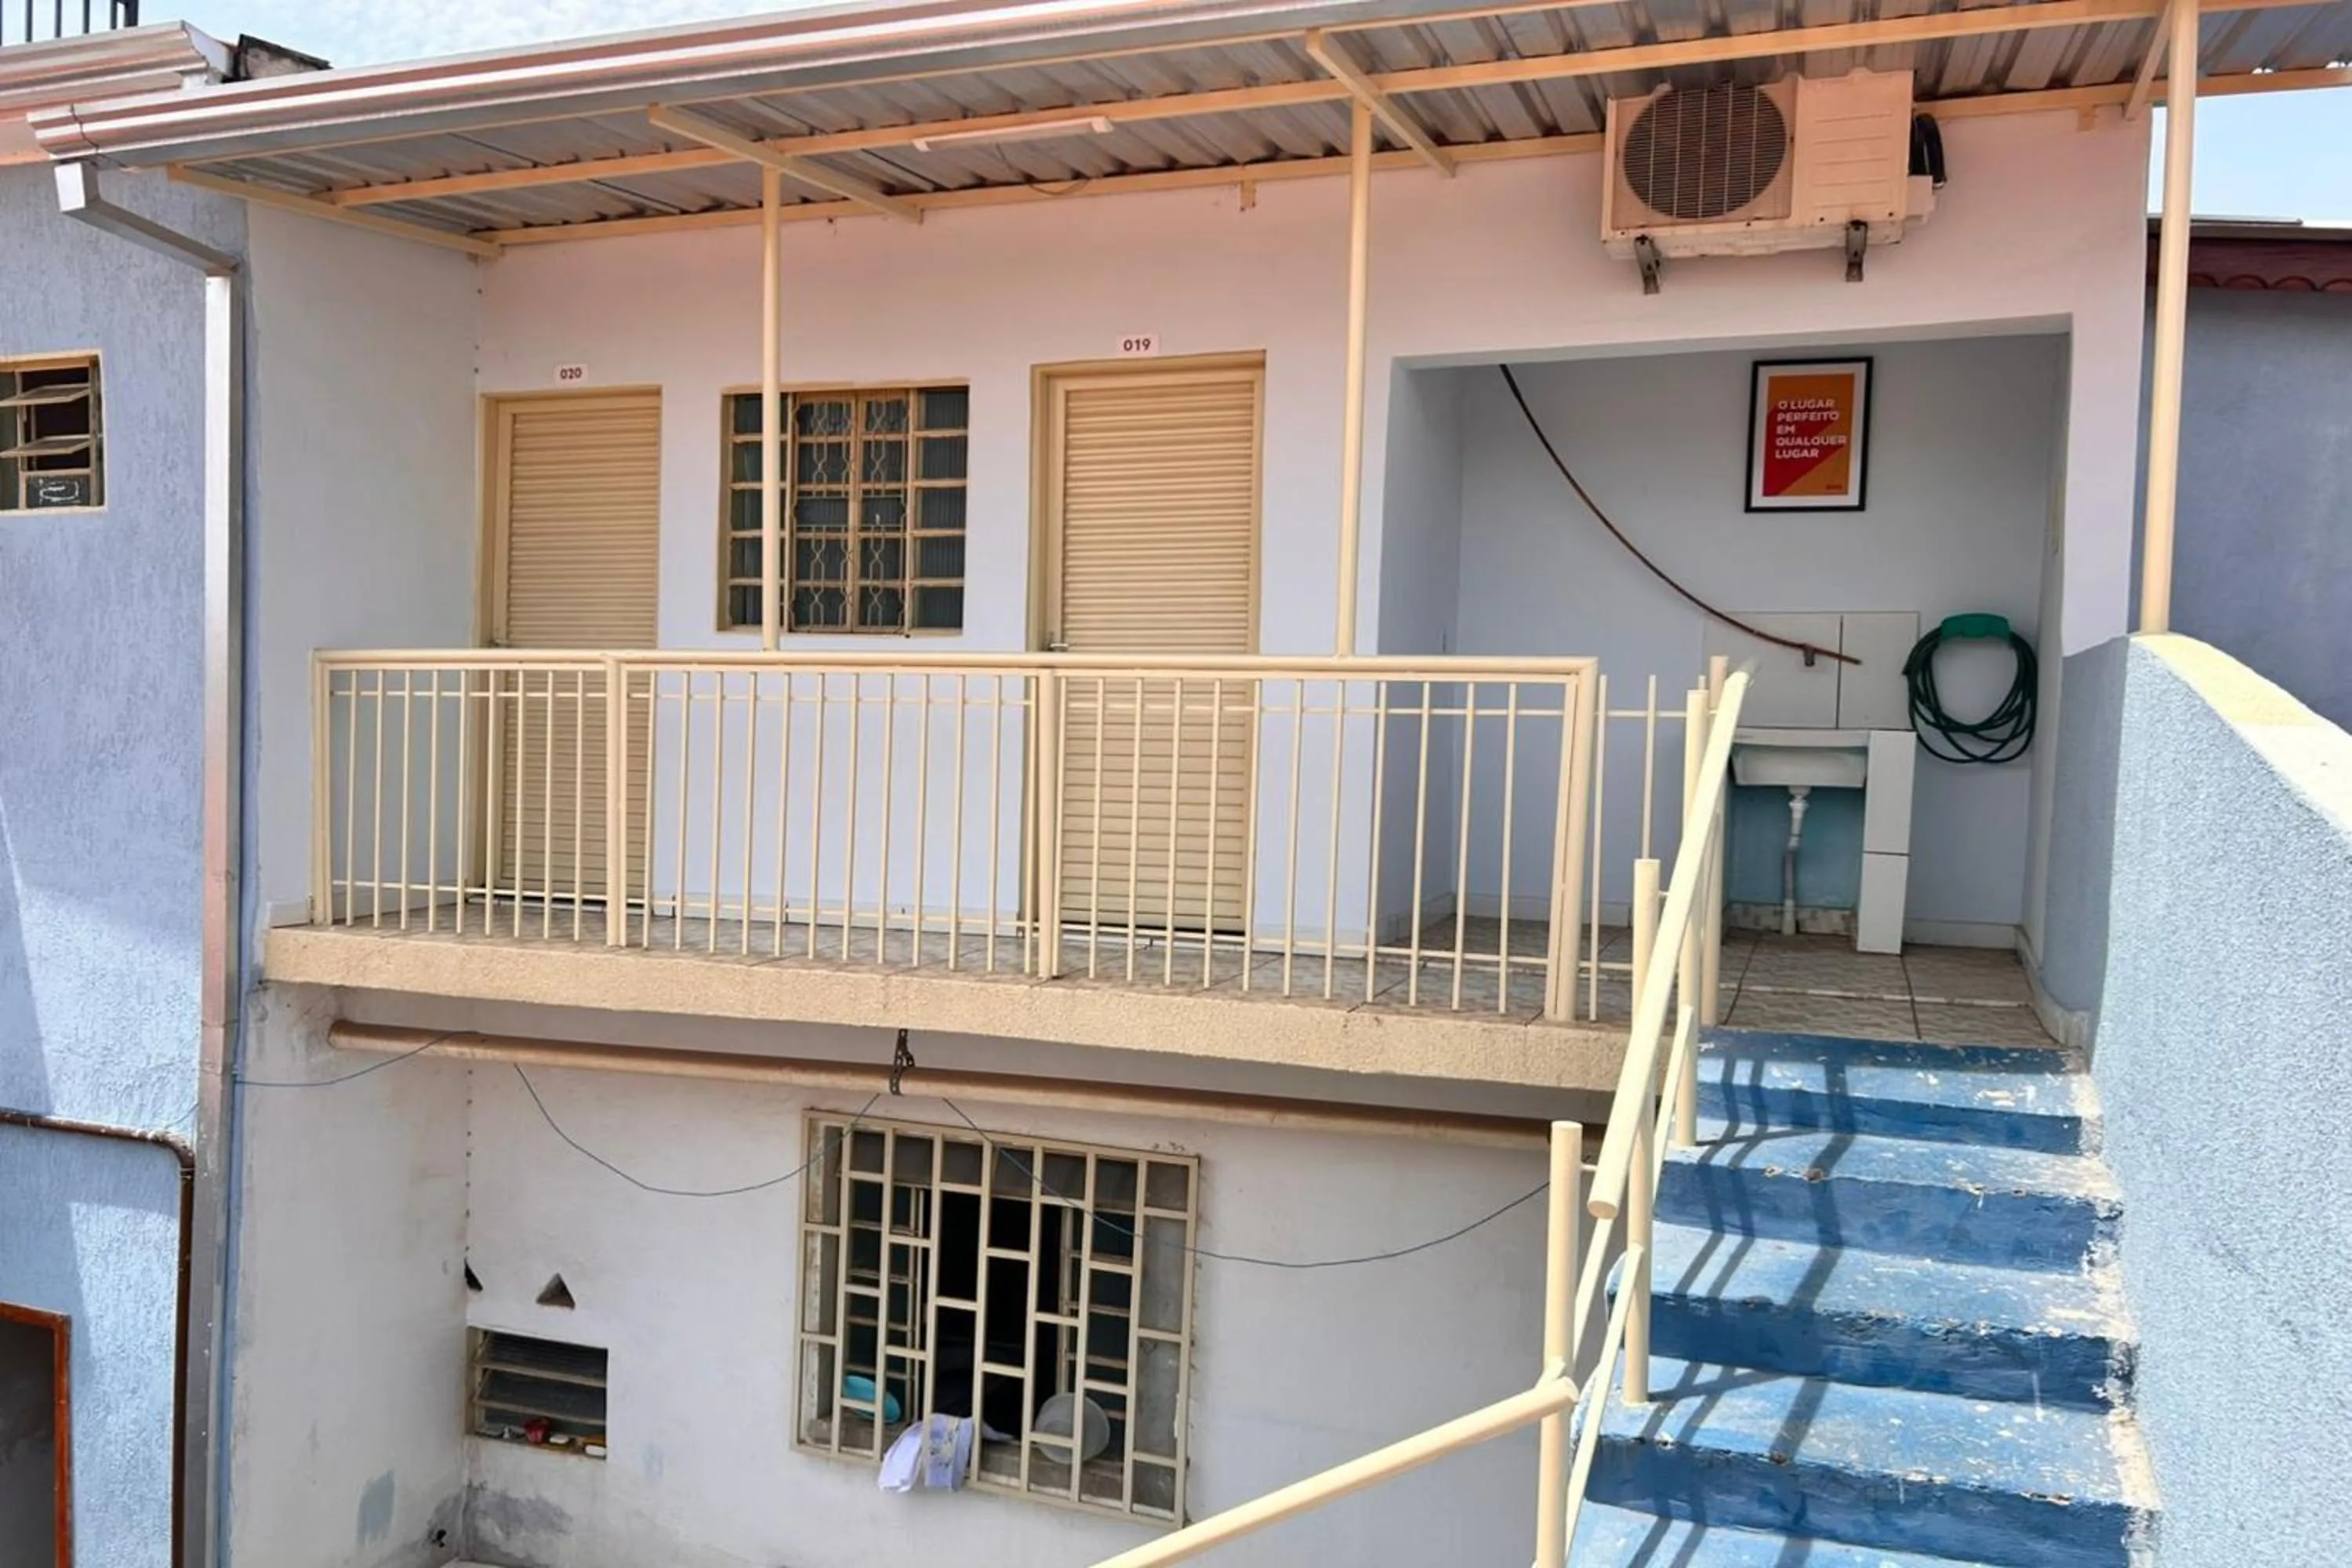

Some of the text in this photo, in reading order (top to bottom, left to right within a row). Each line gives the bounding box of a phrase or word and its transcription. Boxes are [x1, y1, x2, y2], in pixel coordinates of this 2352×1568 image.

[1123, 338, 1151, 351] 019
[560, 367, 583, 379] 020
[1778, 399, 1835, 409] O LUGAR
[1777, 411, 1839, 422] PERFEITO
[1777, 424, 1795, 434] EM
[1776, 435, 1847, 446] QUALQUER
[1775, 448, 1819, 459] LUGAR
